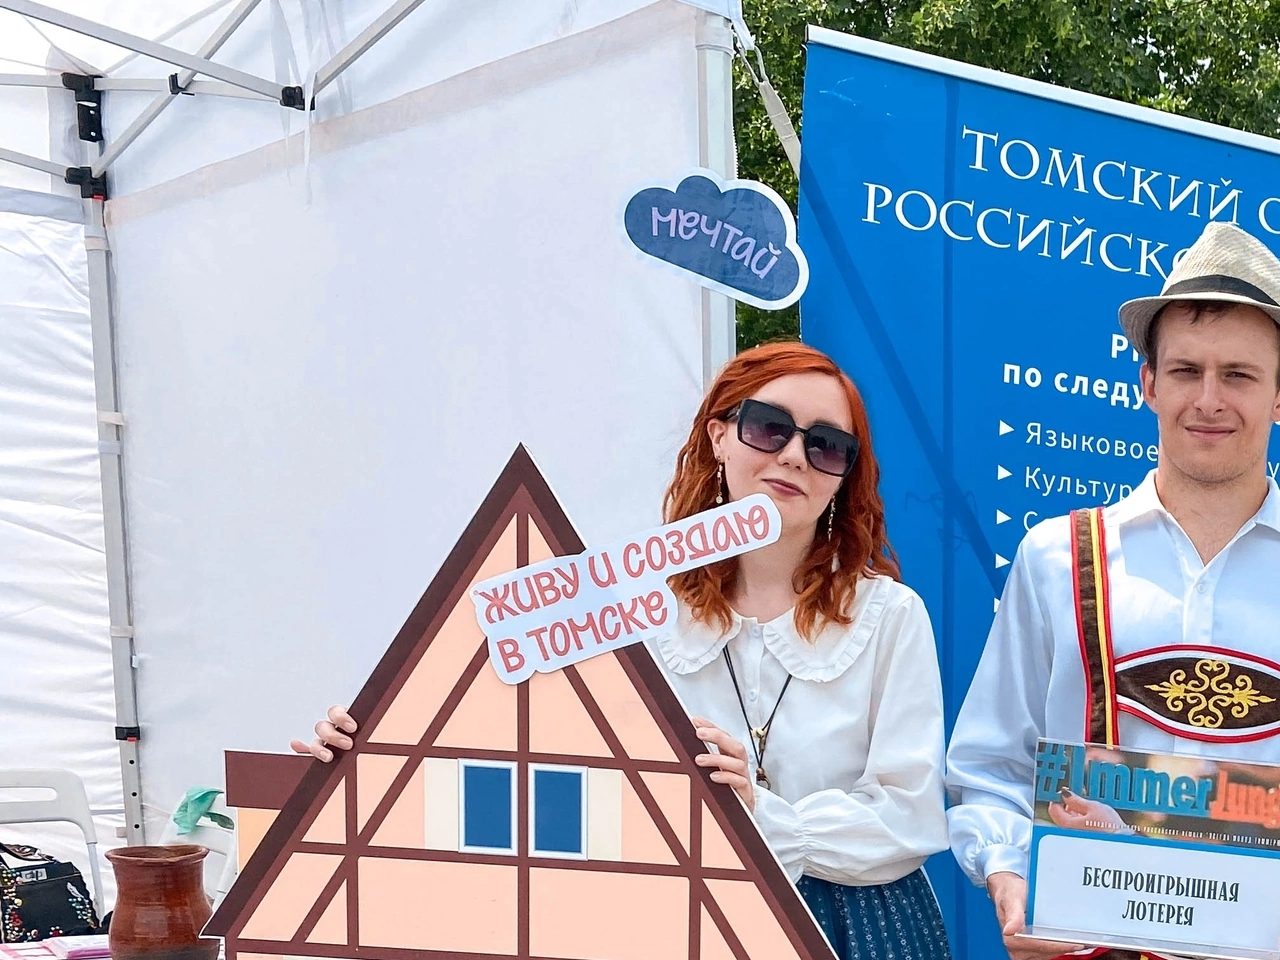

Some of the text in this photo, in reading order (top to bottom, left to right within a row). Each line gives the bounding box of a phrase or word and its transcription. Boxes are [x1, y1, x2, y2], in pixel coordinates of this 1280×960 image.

[962, 124, 1244, 226] ТОМСКИЙ
[1003, 363, 1042, 388] по
[1054, 371, 1145, 411] следу
[1025, 422, 1159, 462] Языковое
[1025, 466, 1133, 505] Культур
[1081, 866, 1240, 903] БЕСПРОИГРЫШНАЯ
[1121, 899, 1195, 927] ЛОТЕРЕЯ
